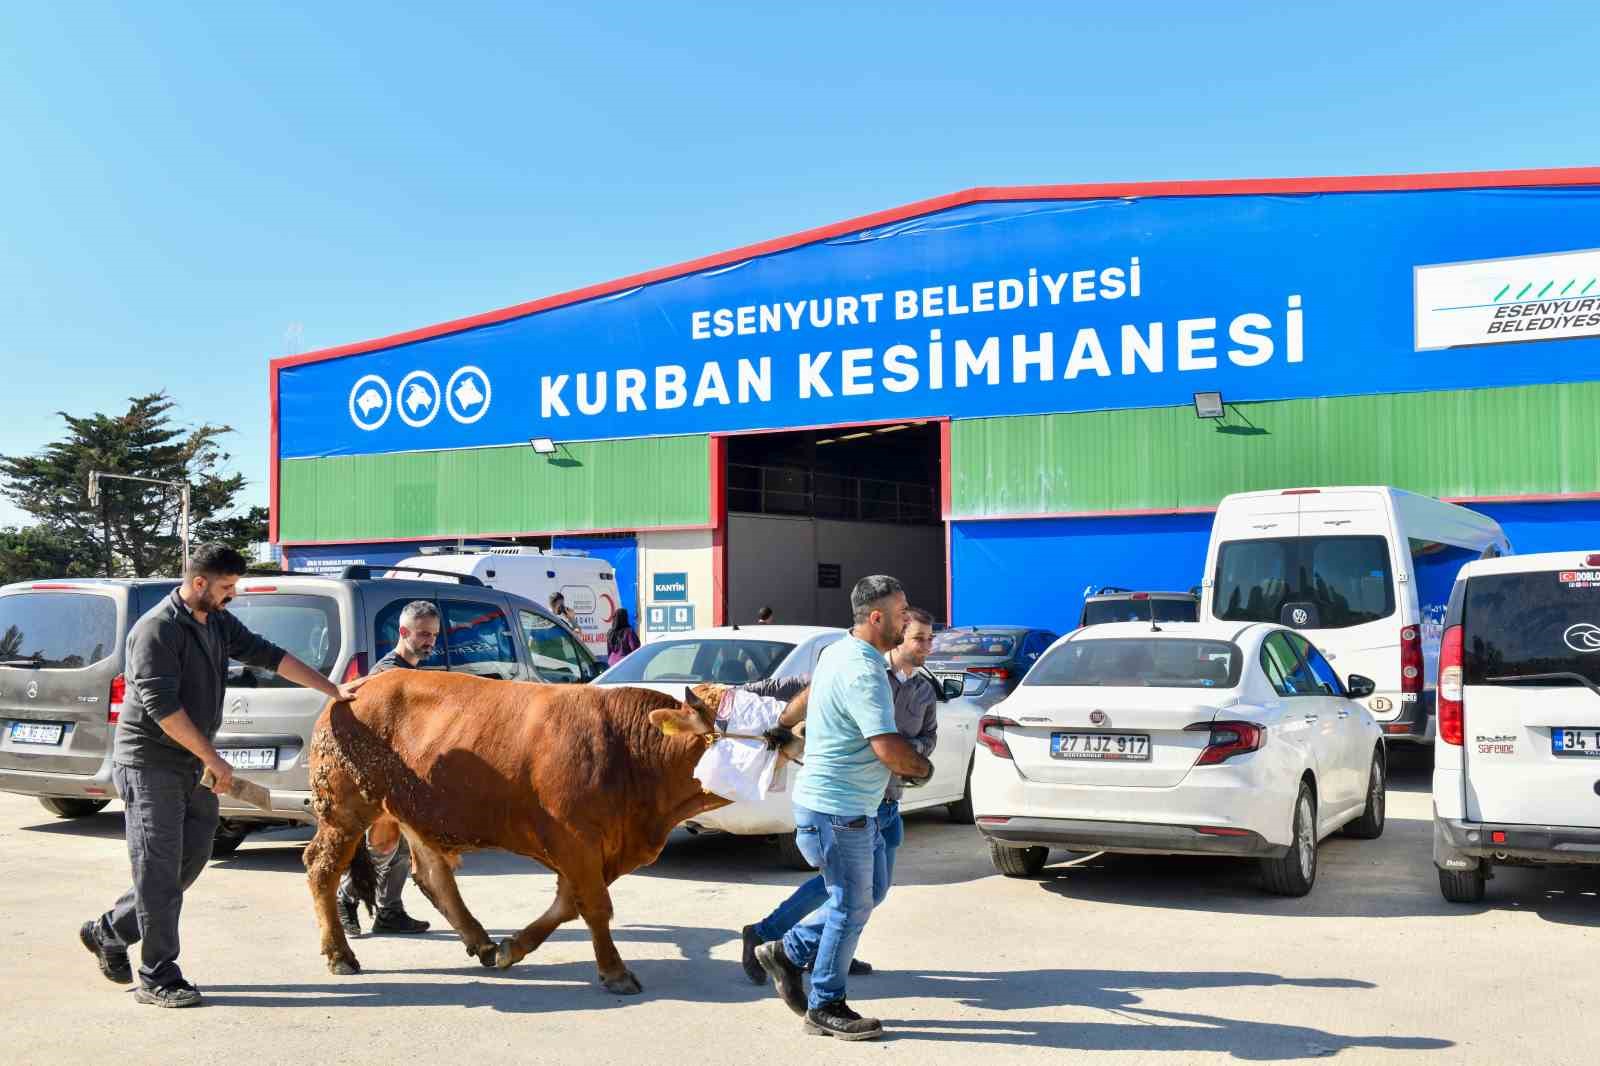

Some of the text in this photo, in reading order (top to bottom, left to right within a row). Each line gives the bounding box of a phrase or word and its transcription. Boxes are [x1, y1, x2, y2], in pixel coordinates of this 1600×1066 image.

[691, 256, 1141, 340] ESENYURT BELEDİYESİ
[540, 294, 1304, 419] KURBAN KESİMHANESİ
[655, 582, 685, 592] KANTİN
[1060, 736, 1146, 753] 27 AJZ 917
[1565, 731, 1586, 749] 34
